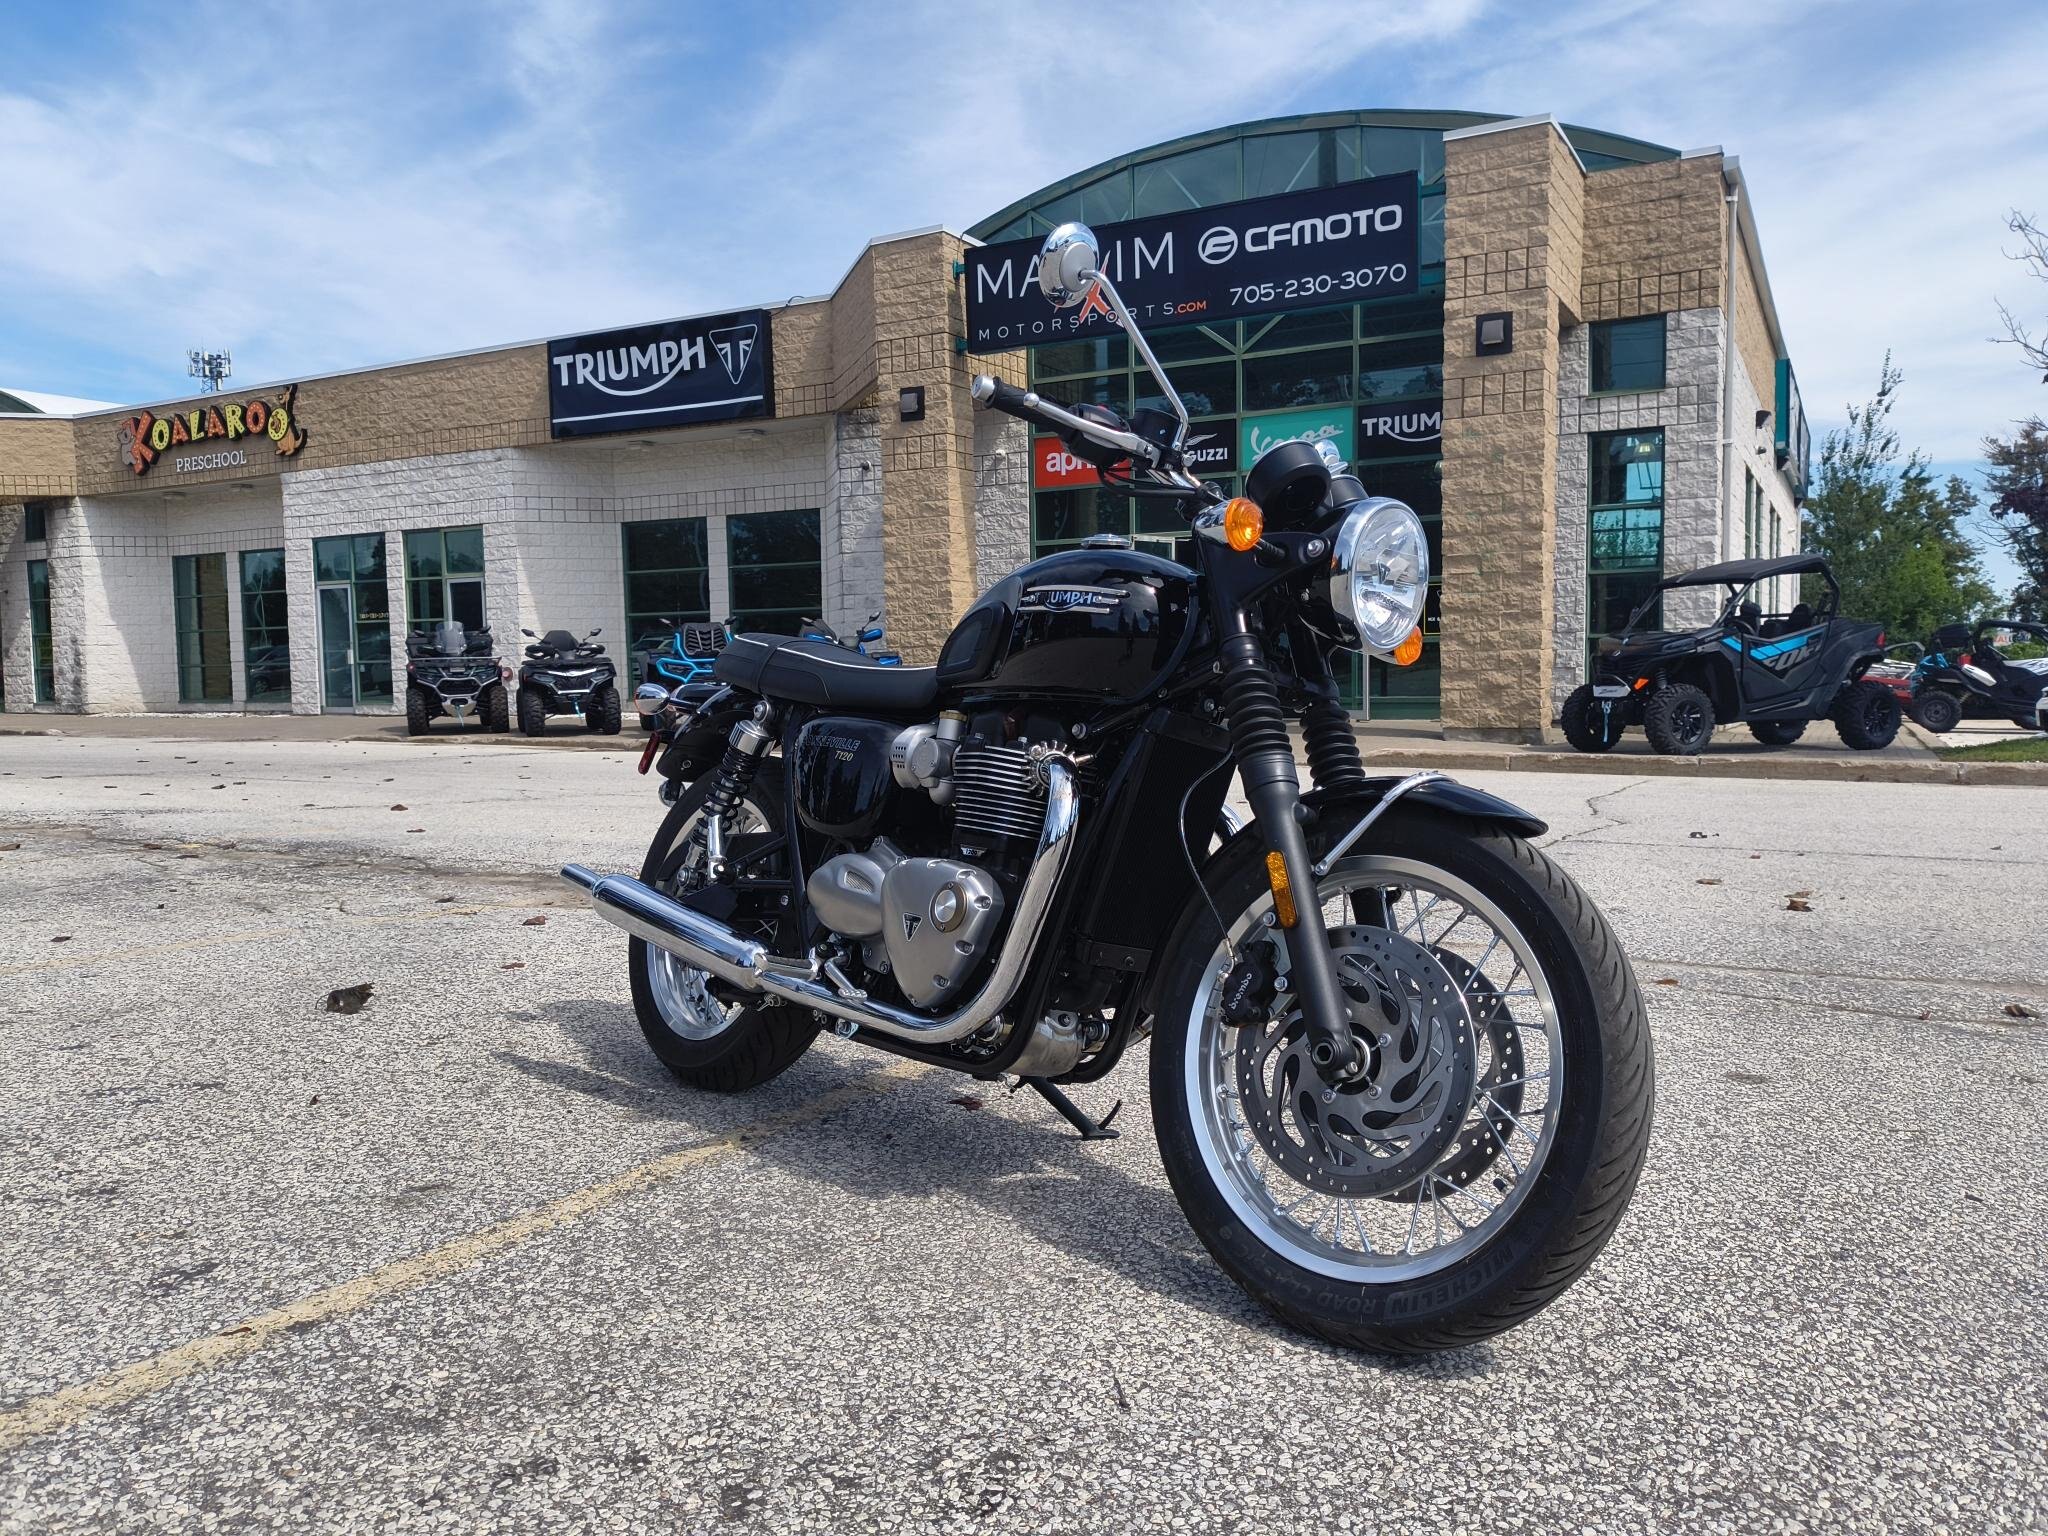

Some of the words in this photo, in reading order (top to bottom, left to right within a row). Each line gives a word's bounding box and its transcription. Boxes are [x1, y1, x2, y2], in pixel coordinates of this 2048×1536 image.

[1244, 204, 1403, 253] CFMOTO
[1229, 263, 1408, 306] 705-230-3070
[553, 336, 707, 397] TRIUMPH
[131, 400, 289, 475] KOALAROO
[1361, 411, 1441, 442] TRIUM
[176, 450, 247, 472] PRESCHOOL
[1034, 591, 1093, 610] TIUMPH
[834, 750, 854, 762] T120
[1228, 972, 1253, 1010] brembo
[1389, 1245, 1514, 1315] MICHELIN
[1316, 1291, 1376, 1314] ROAD
